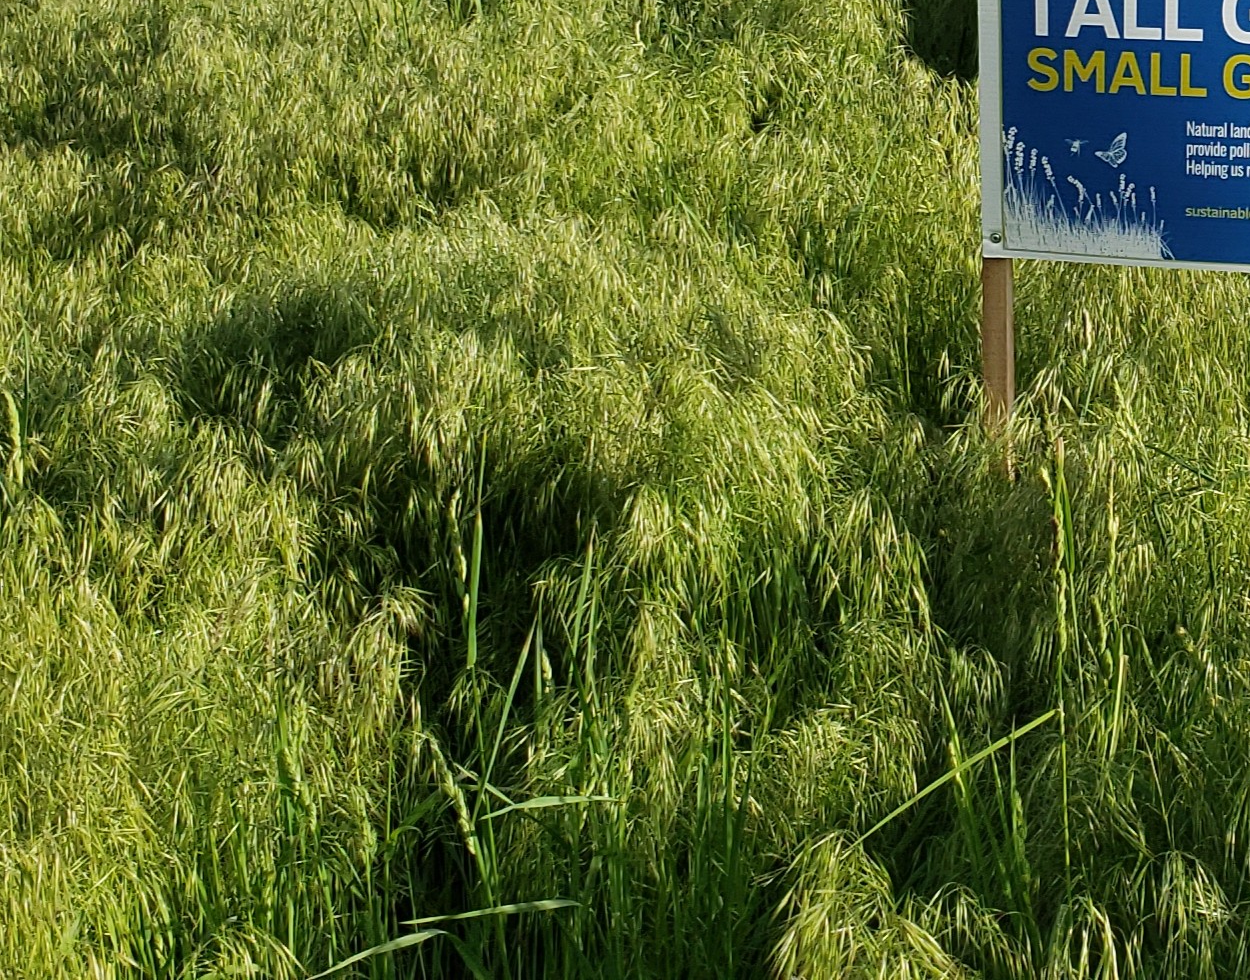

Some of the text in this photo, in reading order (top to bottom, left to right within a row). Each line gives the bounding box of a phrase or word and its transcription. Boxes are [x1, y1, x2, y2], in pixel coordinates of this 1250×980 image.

[1026, 47, 1207, 98] SMALL
[1186, 121, 1227, 138] Natural
[1186, 142, 1227, 158] provide
[1186, 160, 1229, 179] Helping
[1231, 164, 1244, 177] us
